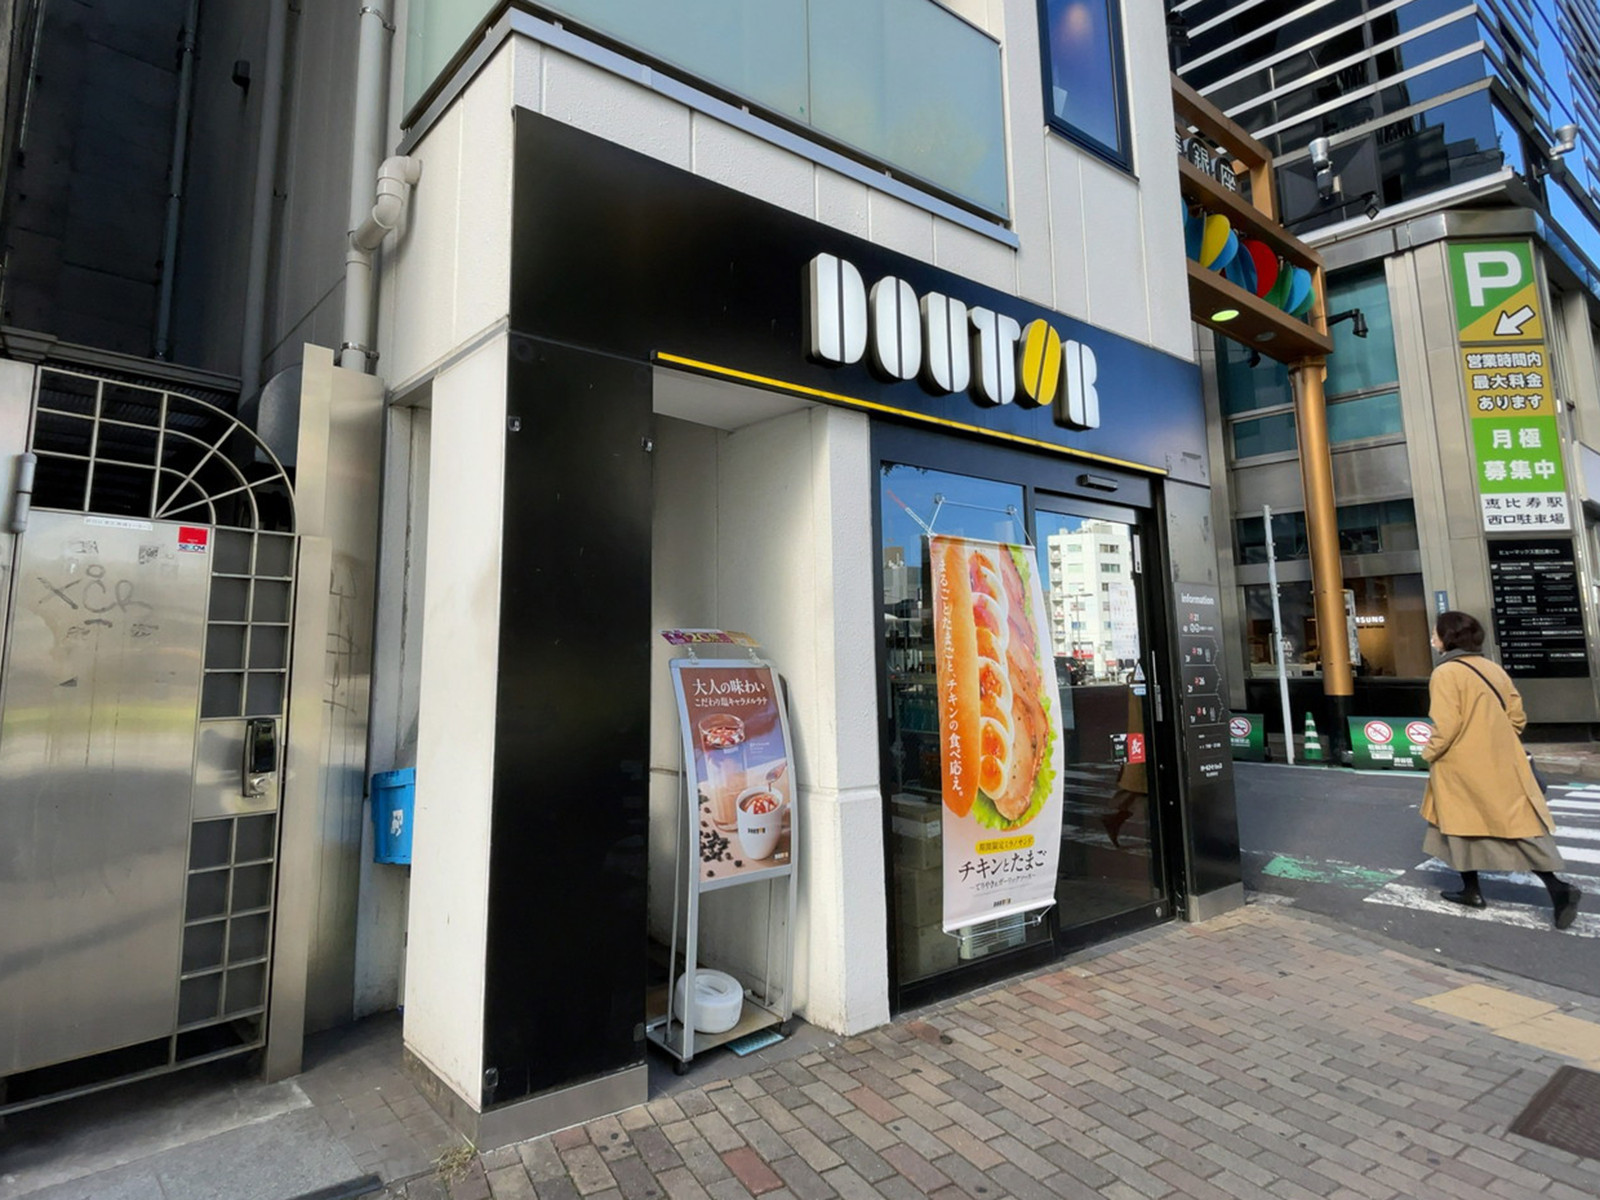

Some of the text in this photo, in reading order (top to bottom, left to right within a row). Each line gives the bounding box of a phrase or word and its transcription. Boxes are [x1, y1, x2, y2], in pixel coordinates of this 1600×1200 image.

[1175, 133, 1236, 192] 銀座
[1463, 250, 1522, 307] P
[809, 252, 1100, 428] DOUTOR
[1466, 351, 1543, 369] 営業時間内
[1472, 372, 1544, 390] 最大料金
[1478, 394, 1542, 411] あります
[1492, 427, 1541, 449] 月極
[1483, 459, 1556, 480] 募集中
[1485, 496, 1564, 510] 恵比寿駅
[1486, 513, 1565, 525] 西口駐車場
[1181, 592, 1215, 606] Information
[692, 678, 766, 696] 大人の味わい
[694, 697, 768, 708] こだわり塩キャラメルラテ
[958, 849, 1047, 882] チキンとたまご
